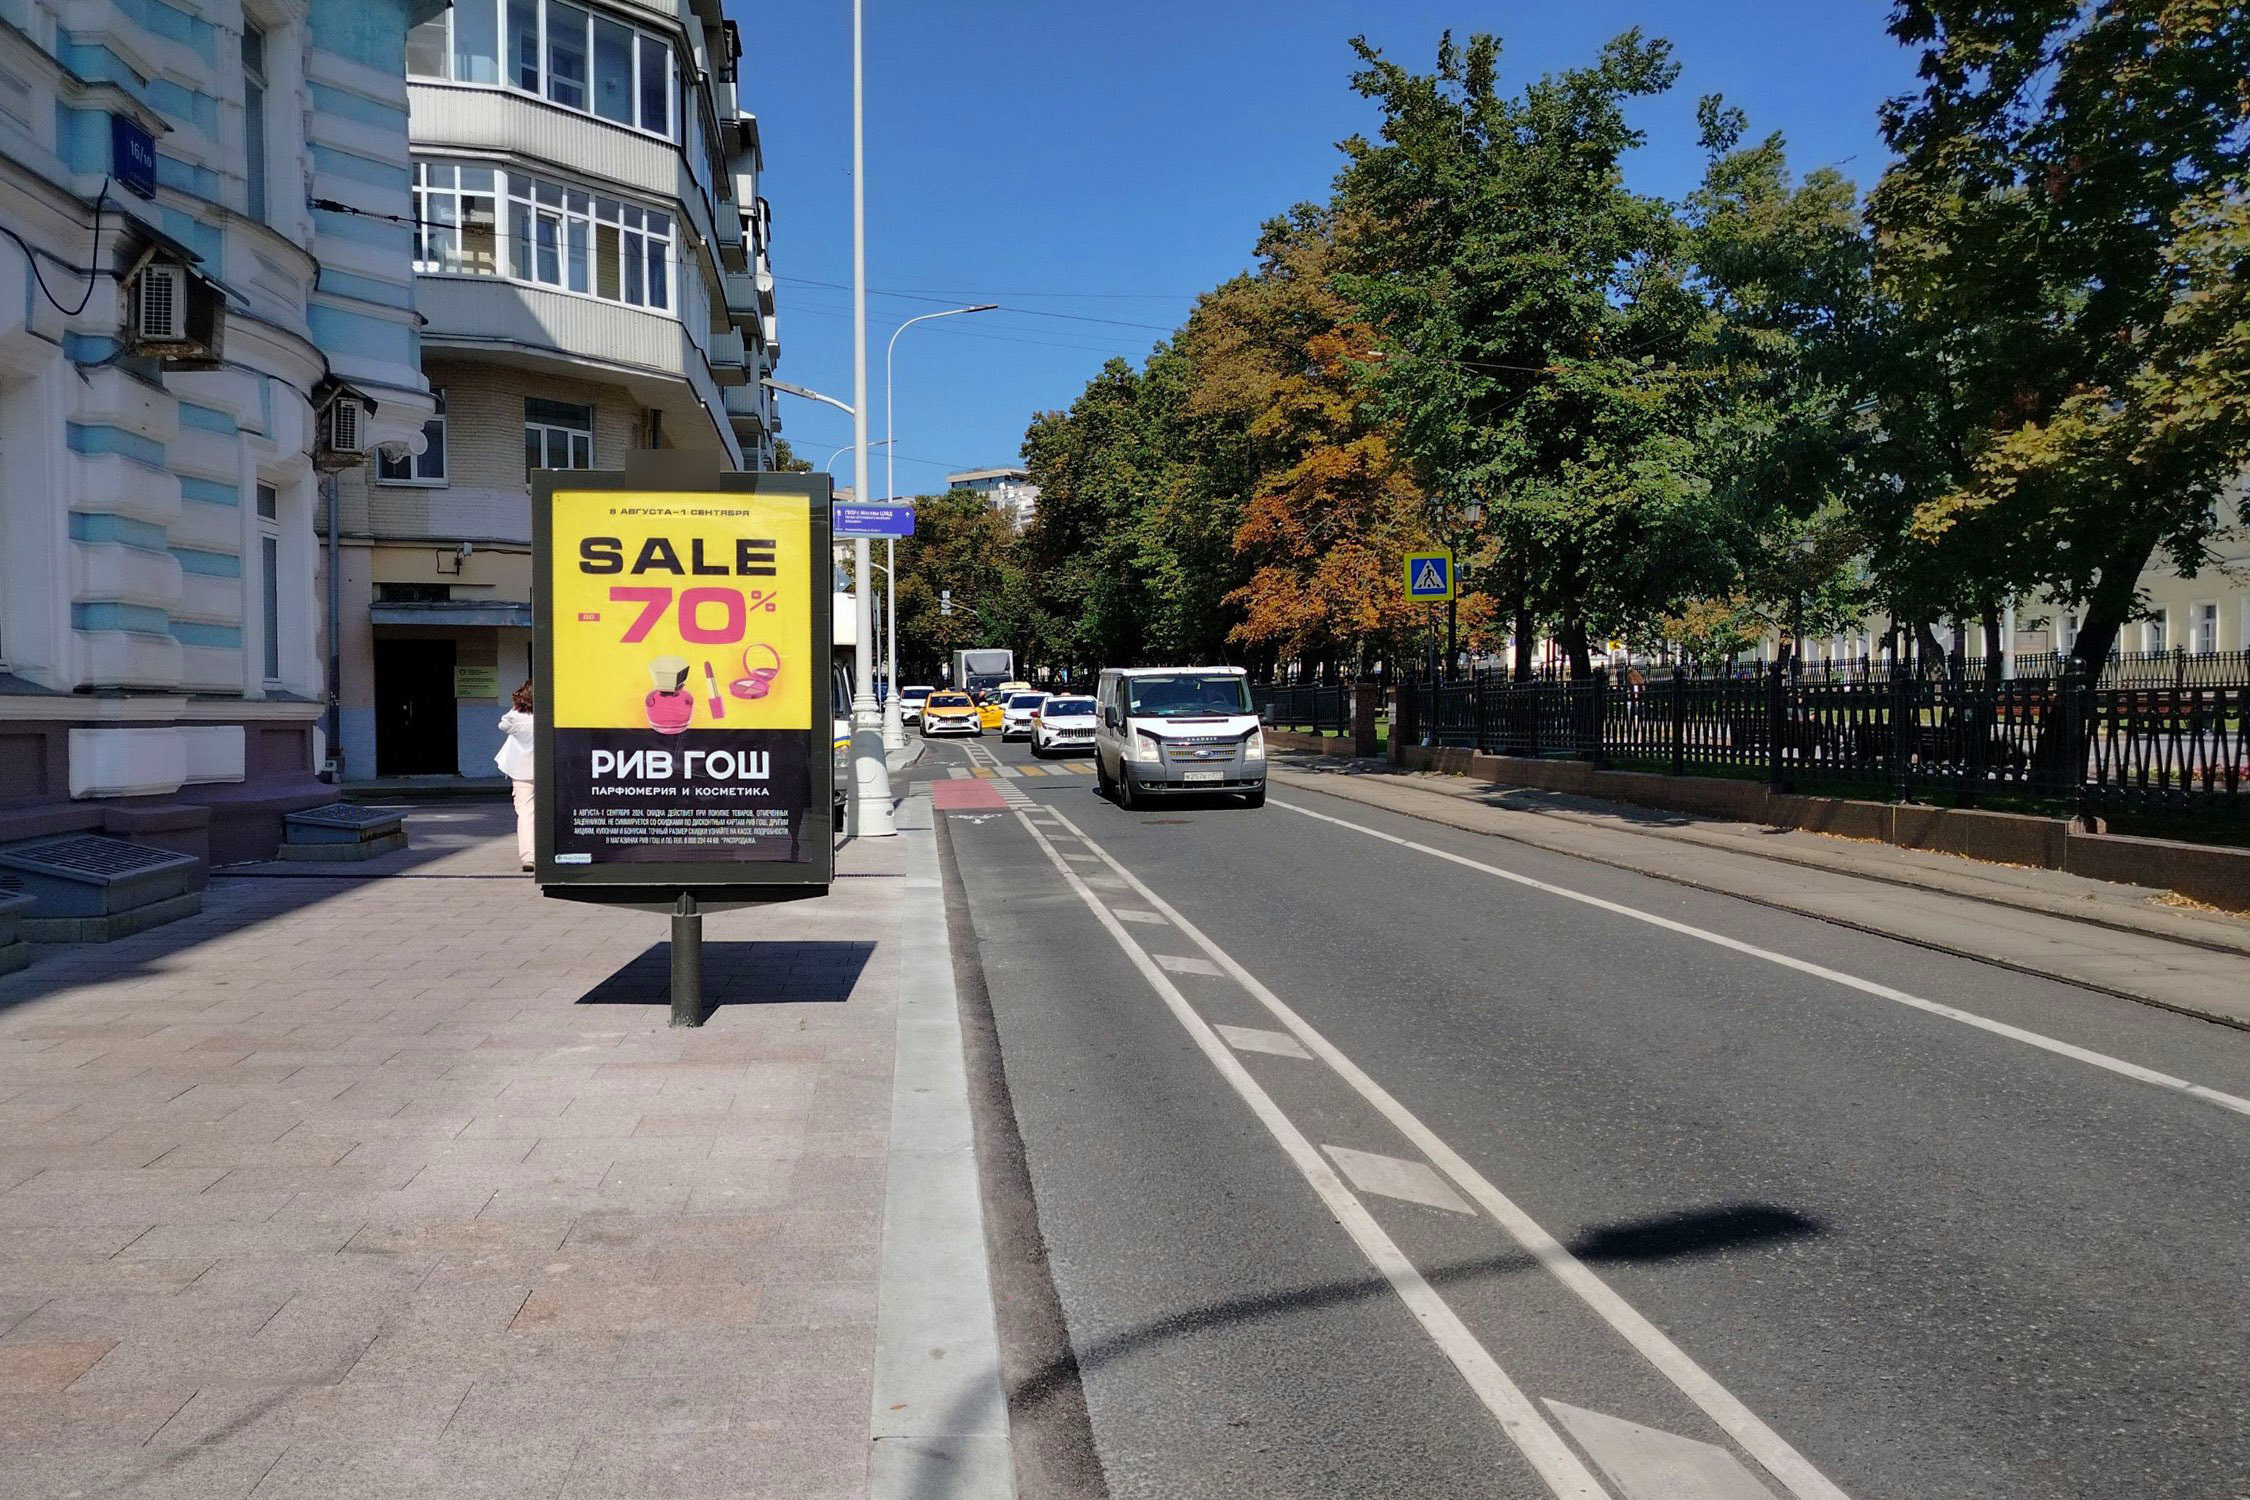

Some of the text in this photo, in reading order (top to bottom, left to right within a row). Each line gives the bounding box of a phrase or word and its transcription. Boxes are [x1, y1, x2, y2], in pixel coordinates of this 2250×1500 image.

[130, 140, 152, 168] 16/10
[690, 509, 750, 517] СЕНТЯБРЯ
[578, 537, 776, 576] SALE
[591, 749, 770, 780] РИВ ГОШ
[591, 786, 770, 797] ПАРФЮМЕРИЯ И КОСМЕТИКА
[646, 809, 666, 817] СКИДКА
[667, 809, 693, 817] ДЕЙСТВУЕТ
[695, 809, 706, 817] ПРИ
[708, 809, 730, 817] ПОКУПКЕ
[756, 809, 789, 817] ОТМЕЧЕННЫХ
[608, 818, 614, 826] НЕ
[614, 818, 649, 826] СУММИРУЕТСЯ
[649, 818, 657, 826] СО
[657, 818, 684, 826] СКИДКАМИ
[684, 818, 691, 826] ПО
[691, 818, 725, 826] ДИСКОНТНЫМ
[726, 818, 745, 826] КАРТАМ
[746, 818, 755, 826] РИВ
[769, 818, 789, 826] ДРУГИМ
[596, 827, 619, 835] КУПОНАМ
[648, 827, 668, 835] ТОЧНЫЙ
[669, 827, 688, 835] РАЗМЕР
[688, 827, 708, 835] СКИДКИ
[708, 827, 729, 835] УЗНАЙТЕ
[730, 827, 737, 835] НА
[753, 827, 789, 835] ПОДРОБНОСТИ
